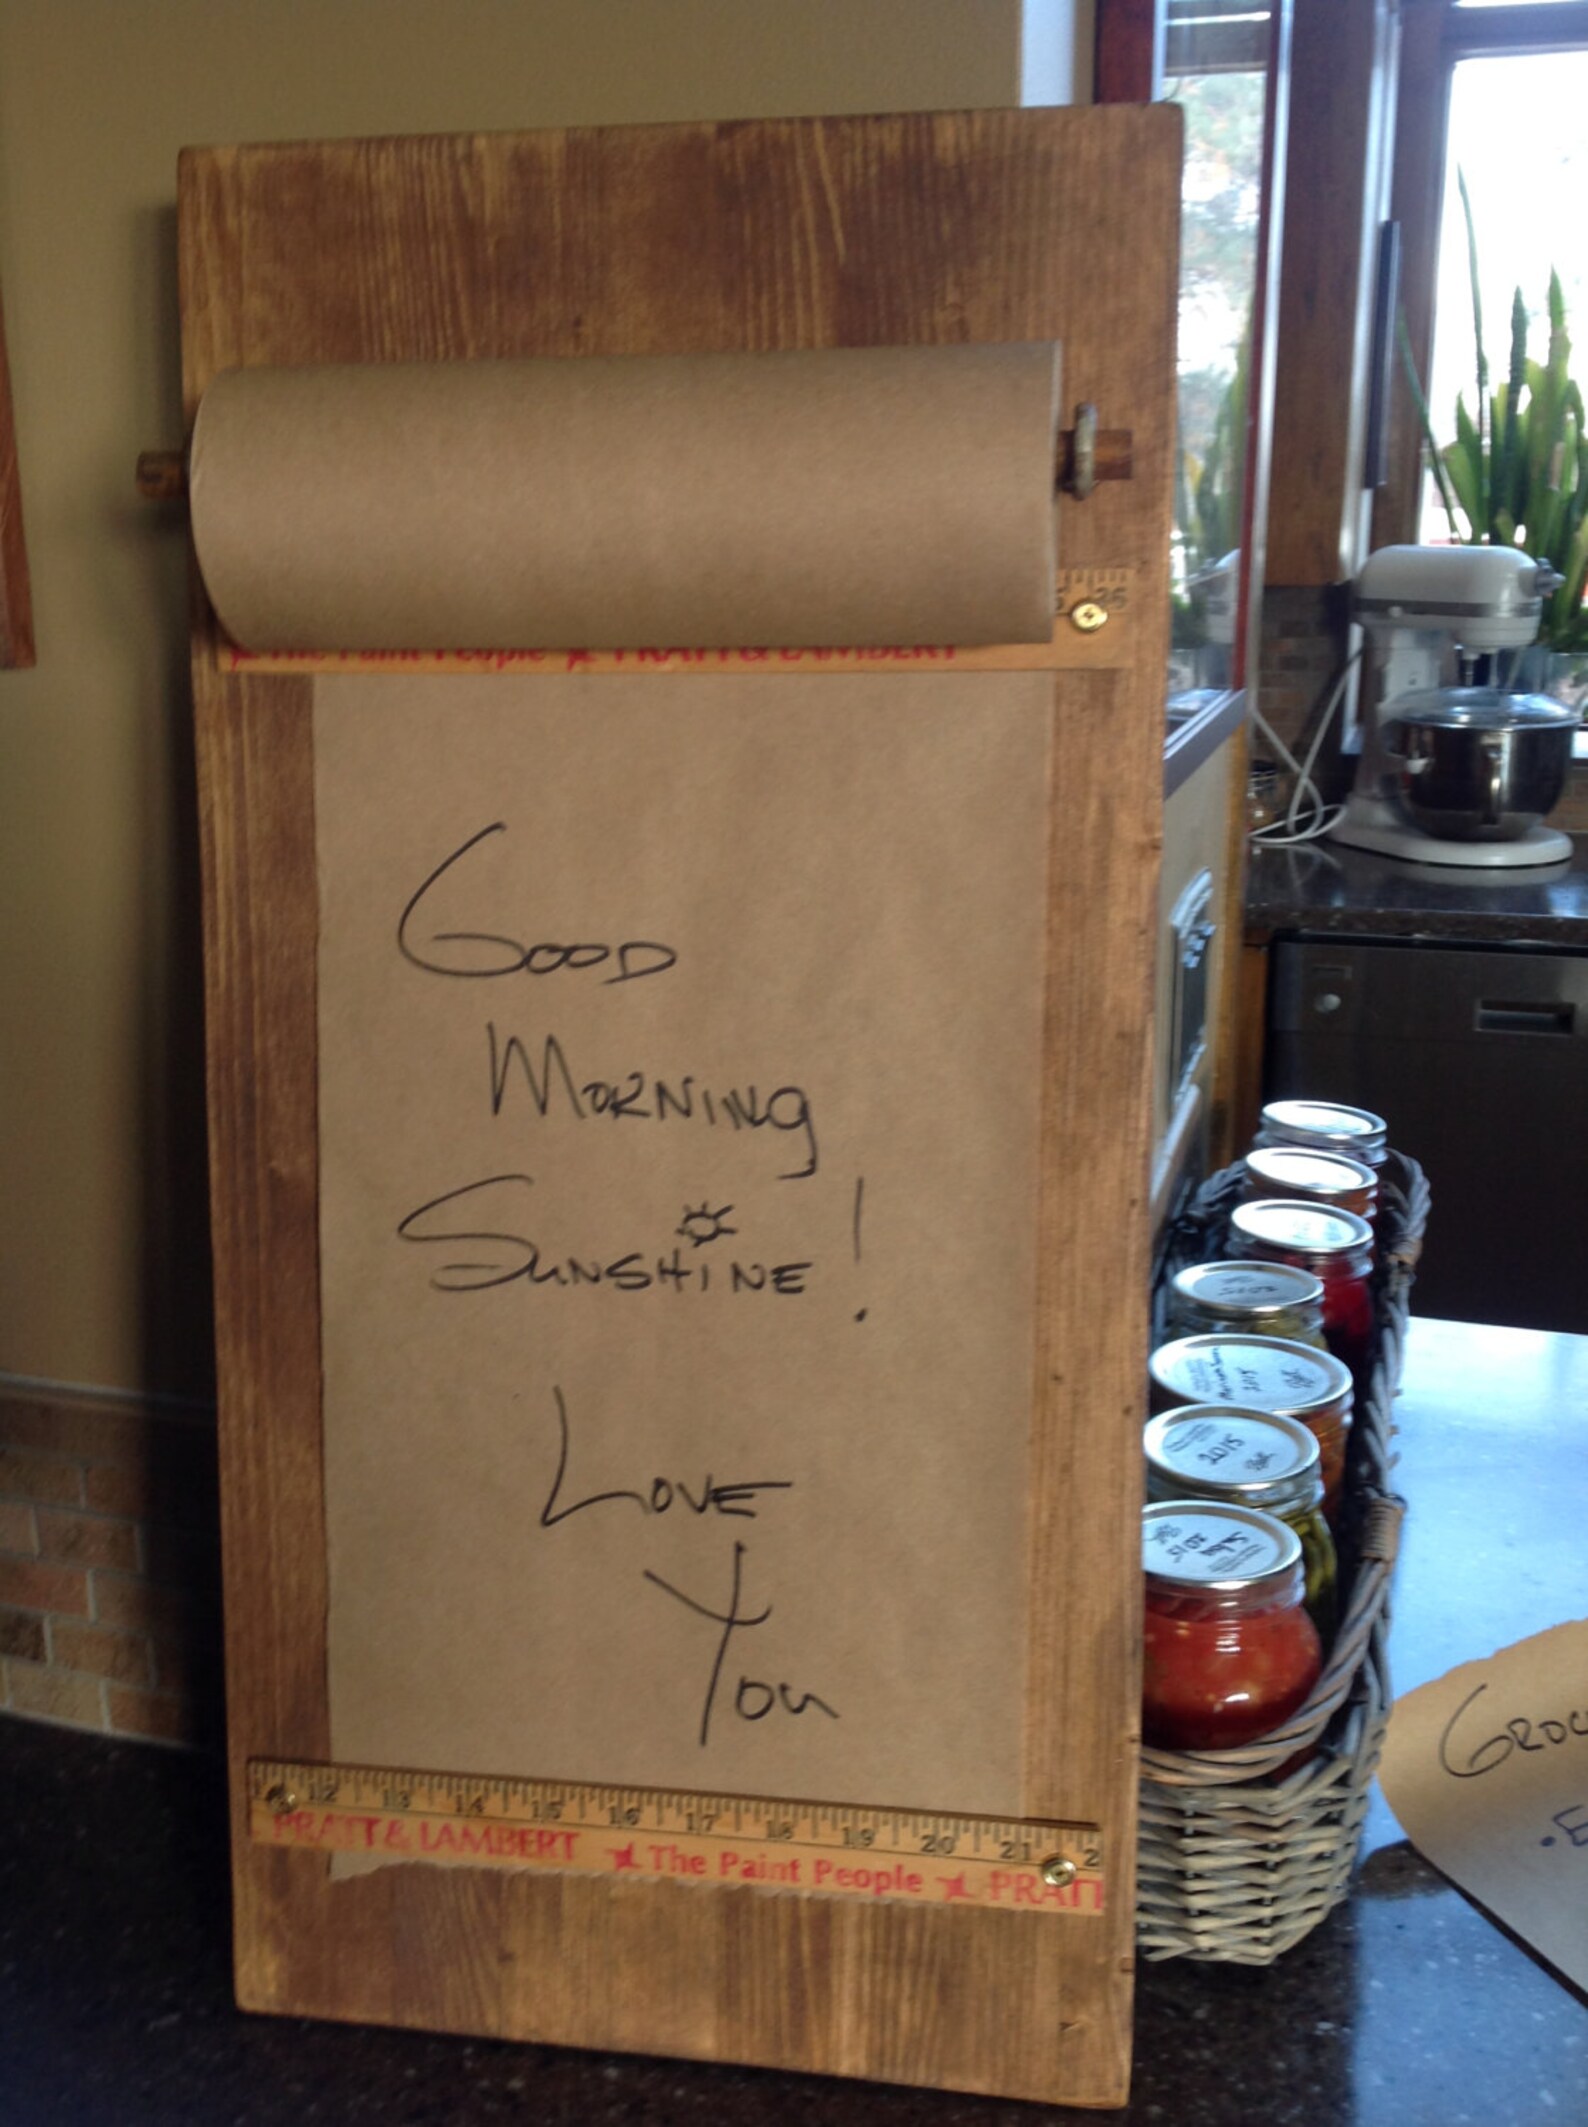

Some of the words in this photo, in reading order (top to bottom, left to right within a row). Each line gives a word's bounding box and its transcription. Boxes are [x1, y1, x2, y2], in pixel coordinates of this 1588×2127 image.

[419, 1818, 582, 1863] LAMBERT
[648, 1843, 707, 1877] The
[718, 1850, 801, 1884] Paint
[813, 1858, 925, 1897] People
[454, 1792, 486, 1817] 14
[531, 1798, 563, 1822] 15
[608, 1804, 641, 1828] 16
[685, 1812, 716, 1834] 17
[842, 1826, 876, 1850] 19
[920, 1834, 957, 1856] 20
[1000, 1840, 1031, 1863] 21
